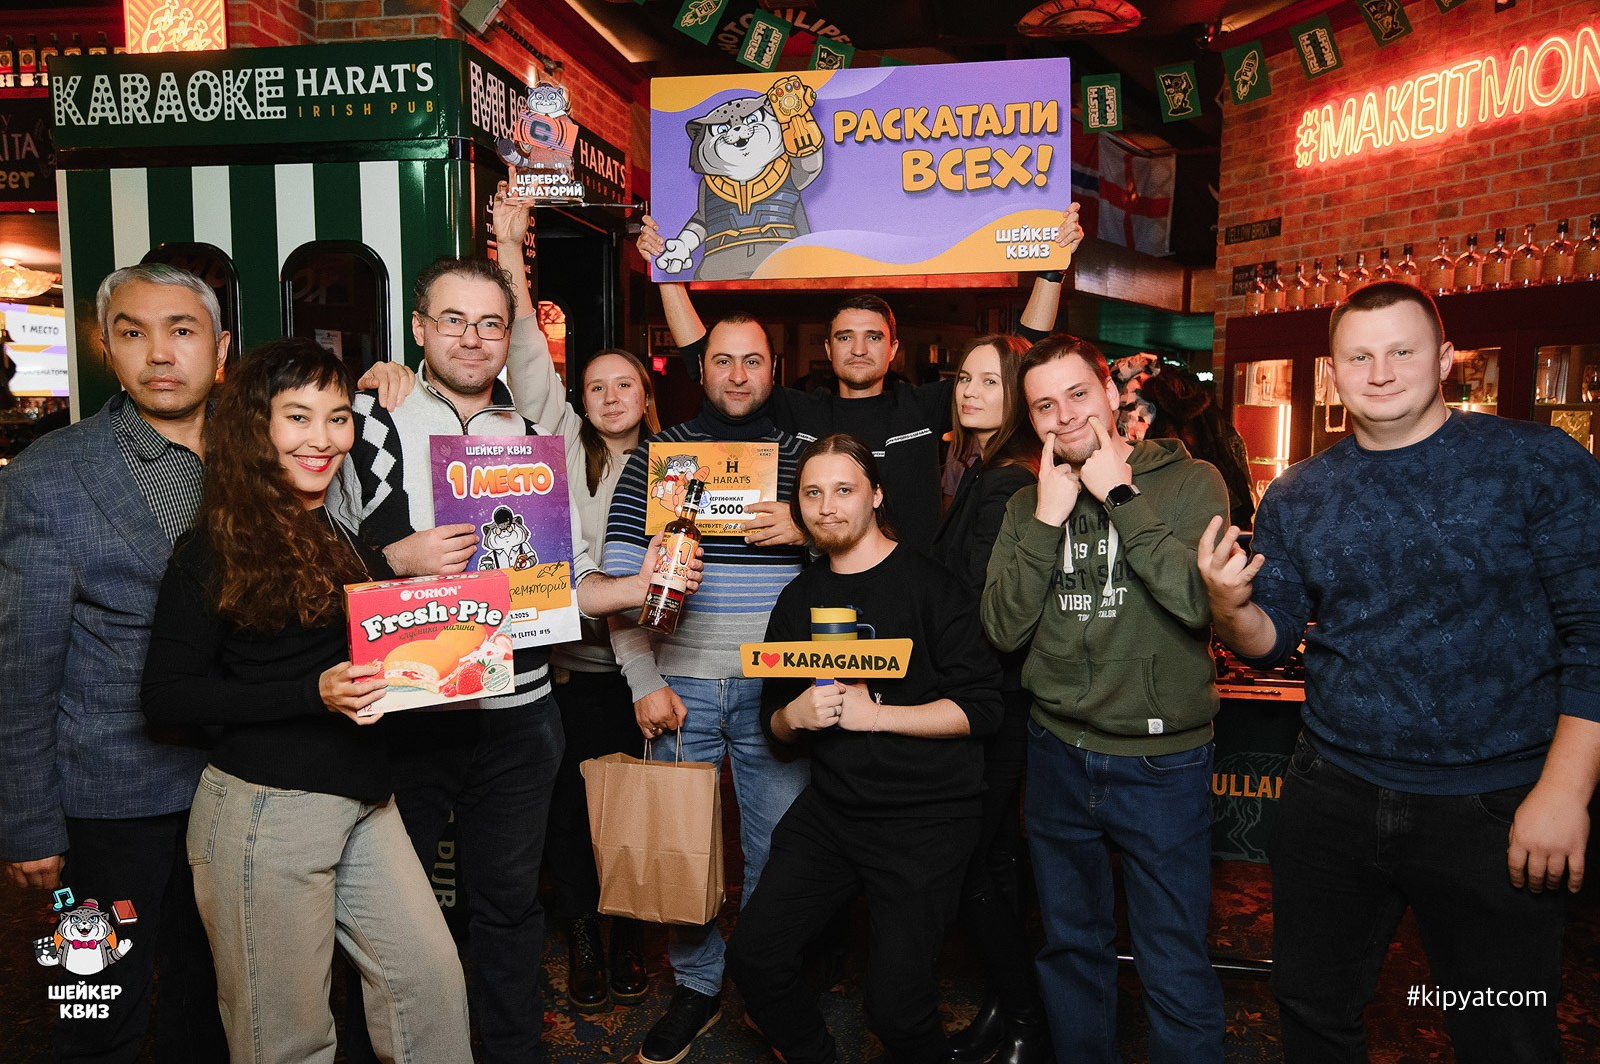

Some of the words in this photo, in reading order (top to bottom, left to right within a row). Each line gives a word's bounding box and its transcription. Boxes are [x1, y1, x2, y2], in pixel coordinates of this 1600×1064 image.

[697, 2, 713, 15] PUB
[746, 23, 766, 60] IRISH
[760, 29, 781, 67] NIGHT
[1300, 34, 1319, 71] IRISH
[295, 62, 434, 97] HARAT'S
[1242, 61, 1255, 78] PUB
[52, 67, 287, 126] KARAOKE
[298, 102, 373, 118] IRISH
[390, 100, 435, 115] PUB
[1089, 88, 1099, 126] IRISH
[1105, 87, 1115, 125] NIGHT
[834, 100, 1058, 144] РАСКАТАЛИ
[902, 145, 1054, 194] ВСЕХ!
[1006, 244, 1050, 260] КВИЗ
[30, 325, 60, 335] МЕСТО
[466, 444, 504, 456] ШЕЙКЕР
[507, 445, 533, 455] КВИЗ
[448, 462, 467, 497] 1
[471, 464, 553, 497] МЕСТО
[710, 504, 743, 515] 5000
[1074, 543, 1089, 560] 19
[414, 586, 458, 600] ORION
[751, 651, 761, 666] I
[783, 652, 900, 671] KARAGANDA
